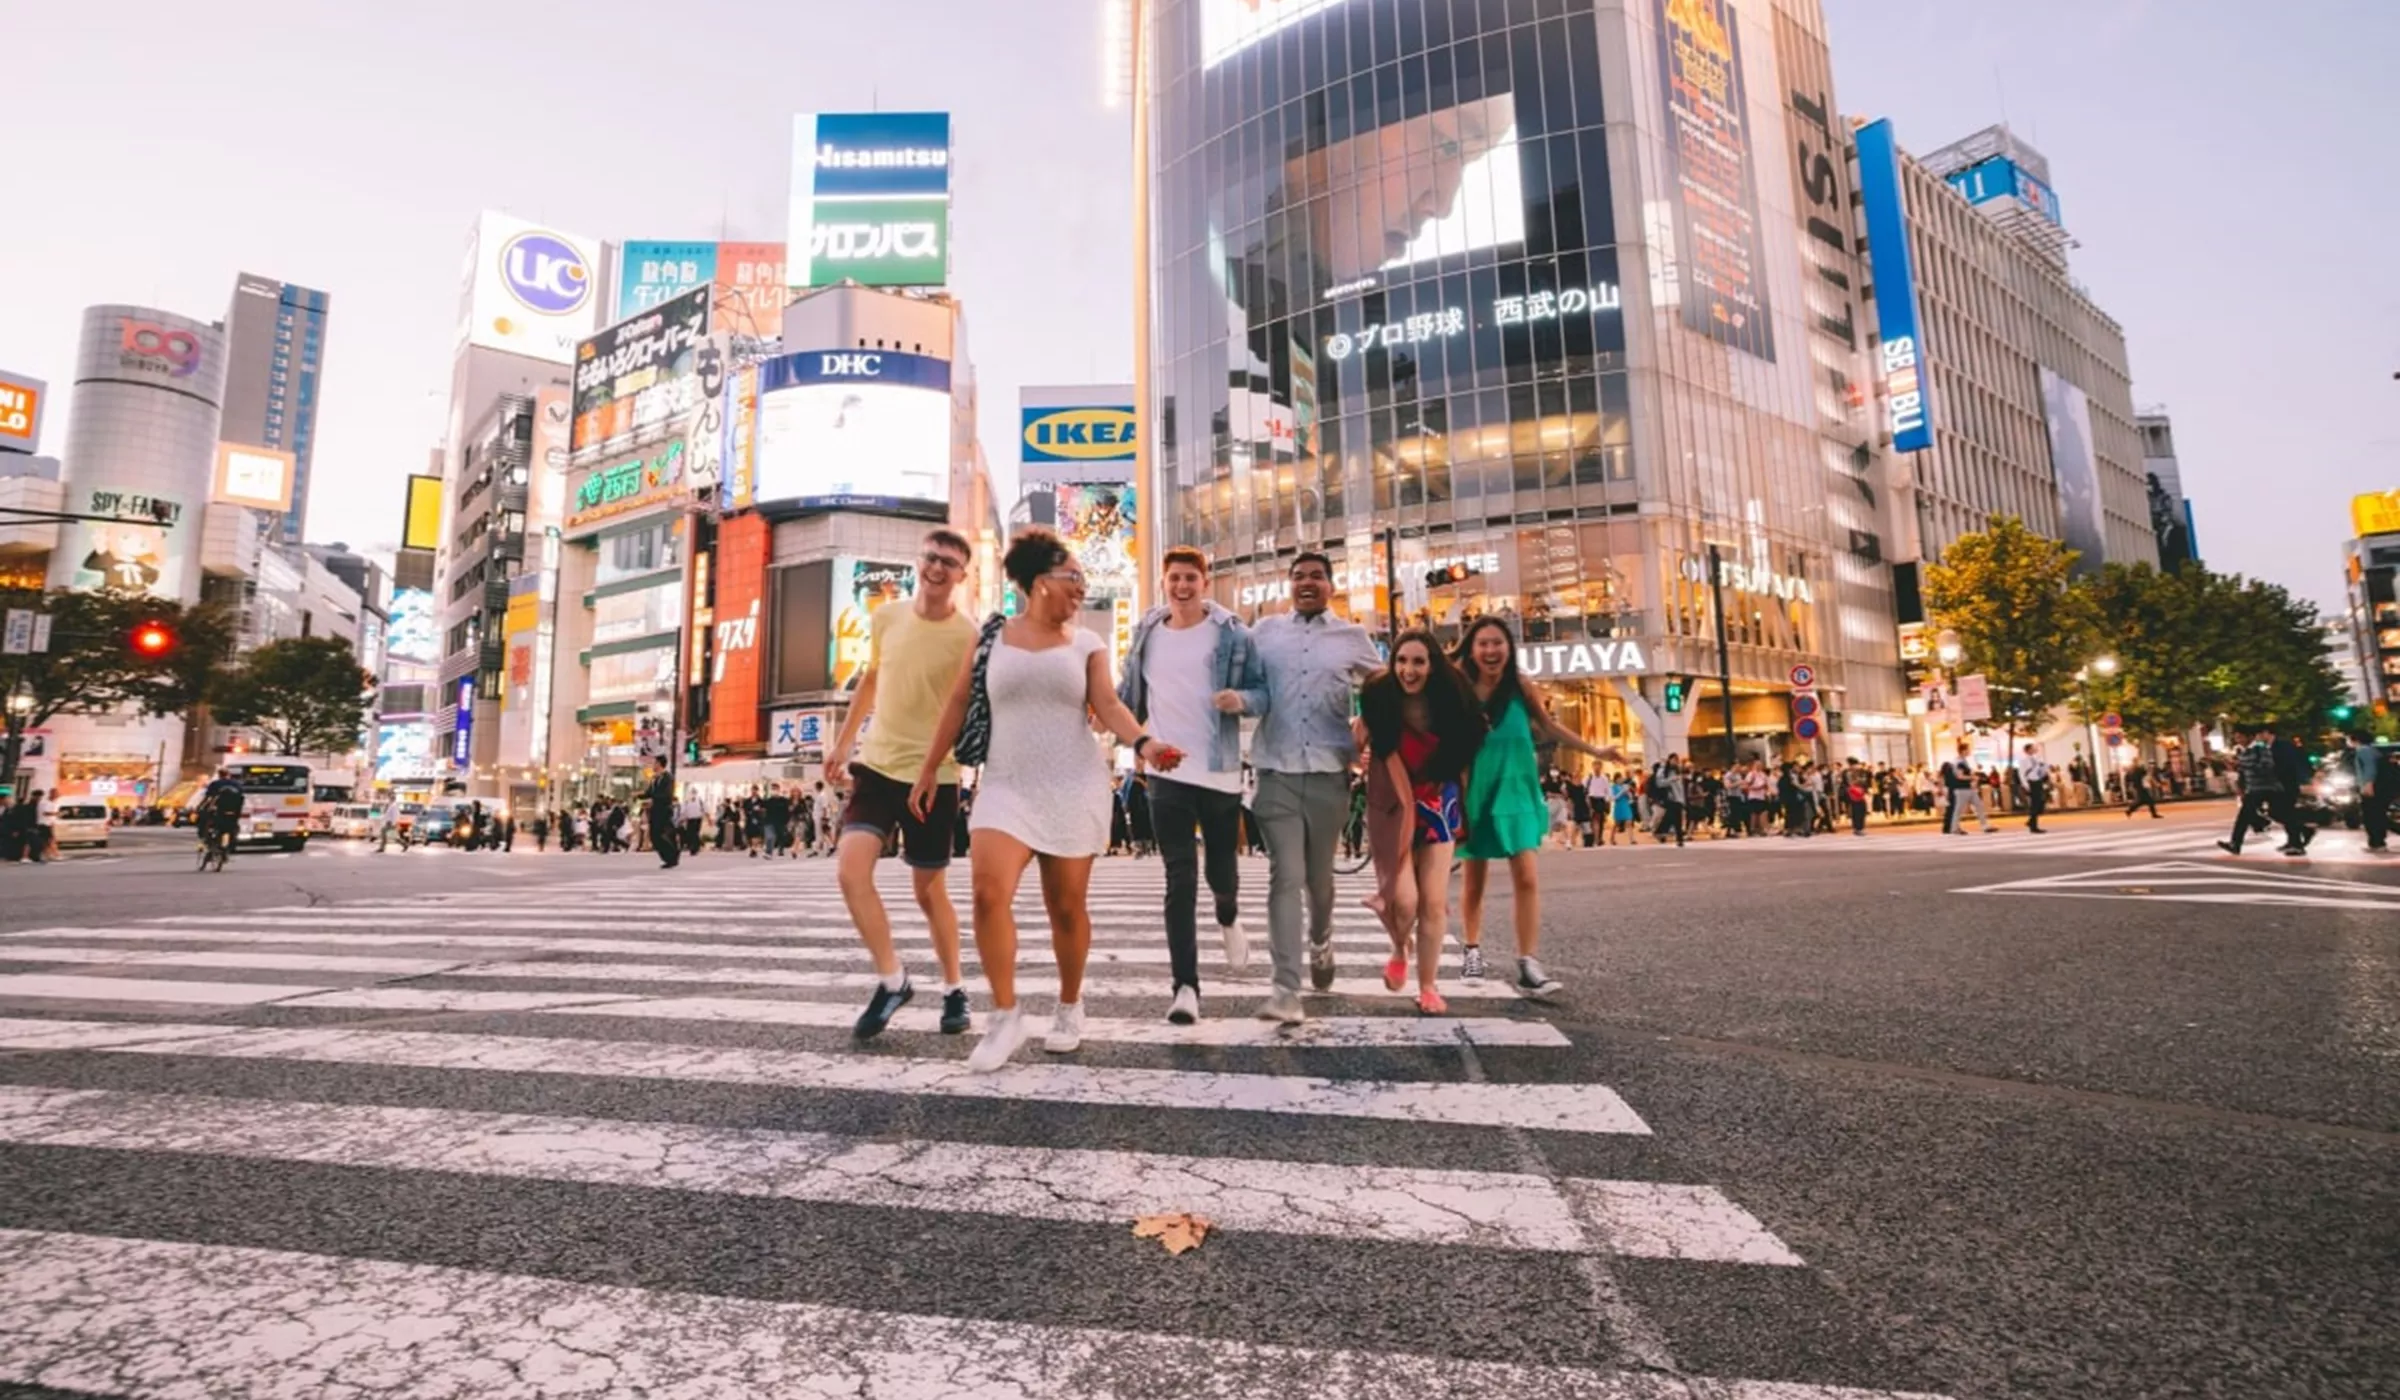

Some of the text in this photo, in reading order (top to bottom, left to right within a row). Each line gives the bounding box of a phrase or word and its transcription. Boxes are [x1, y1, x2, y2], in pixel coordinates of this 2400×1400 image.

[510, 246, 585, 299] UC
[120, 315, 201, 378] 109
[1355, 282, 1619, 353] プロ野球 西武の山
[820, 354, 882, 375] DHC
[1886, 335, 1924, 434] SEIBU
[693, 337, 726, 479] もんじゃ
[778, 716, 819, 743] 大盛
